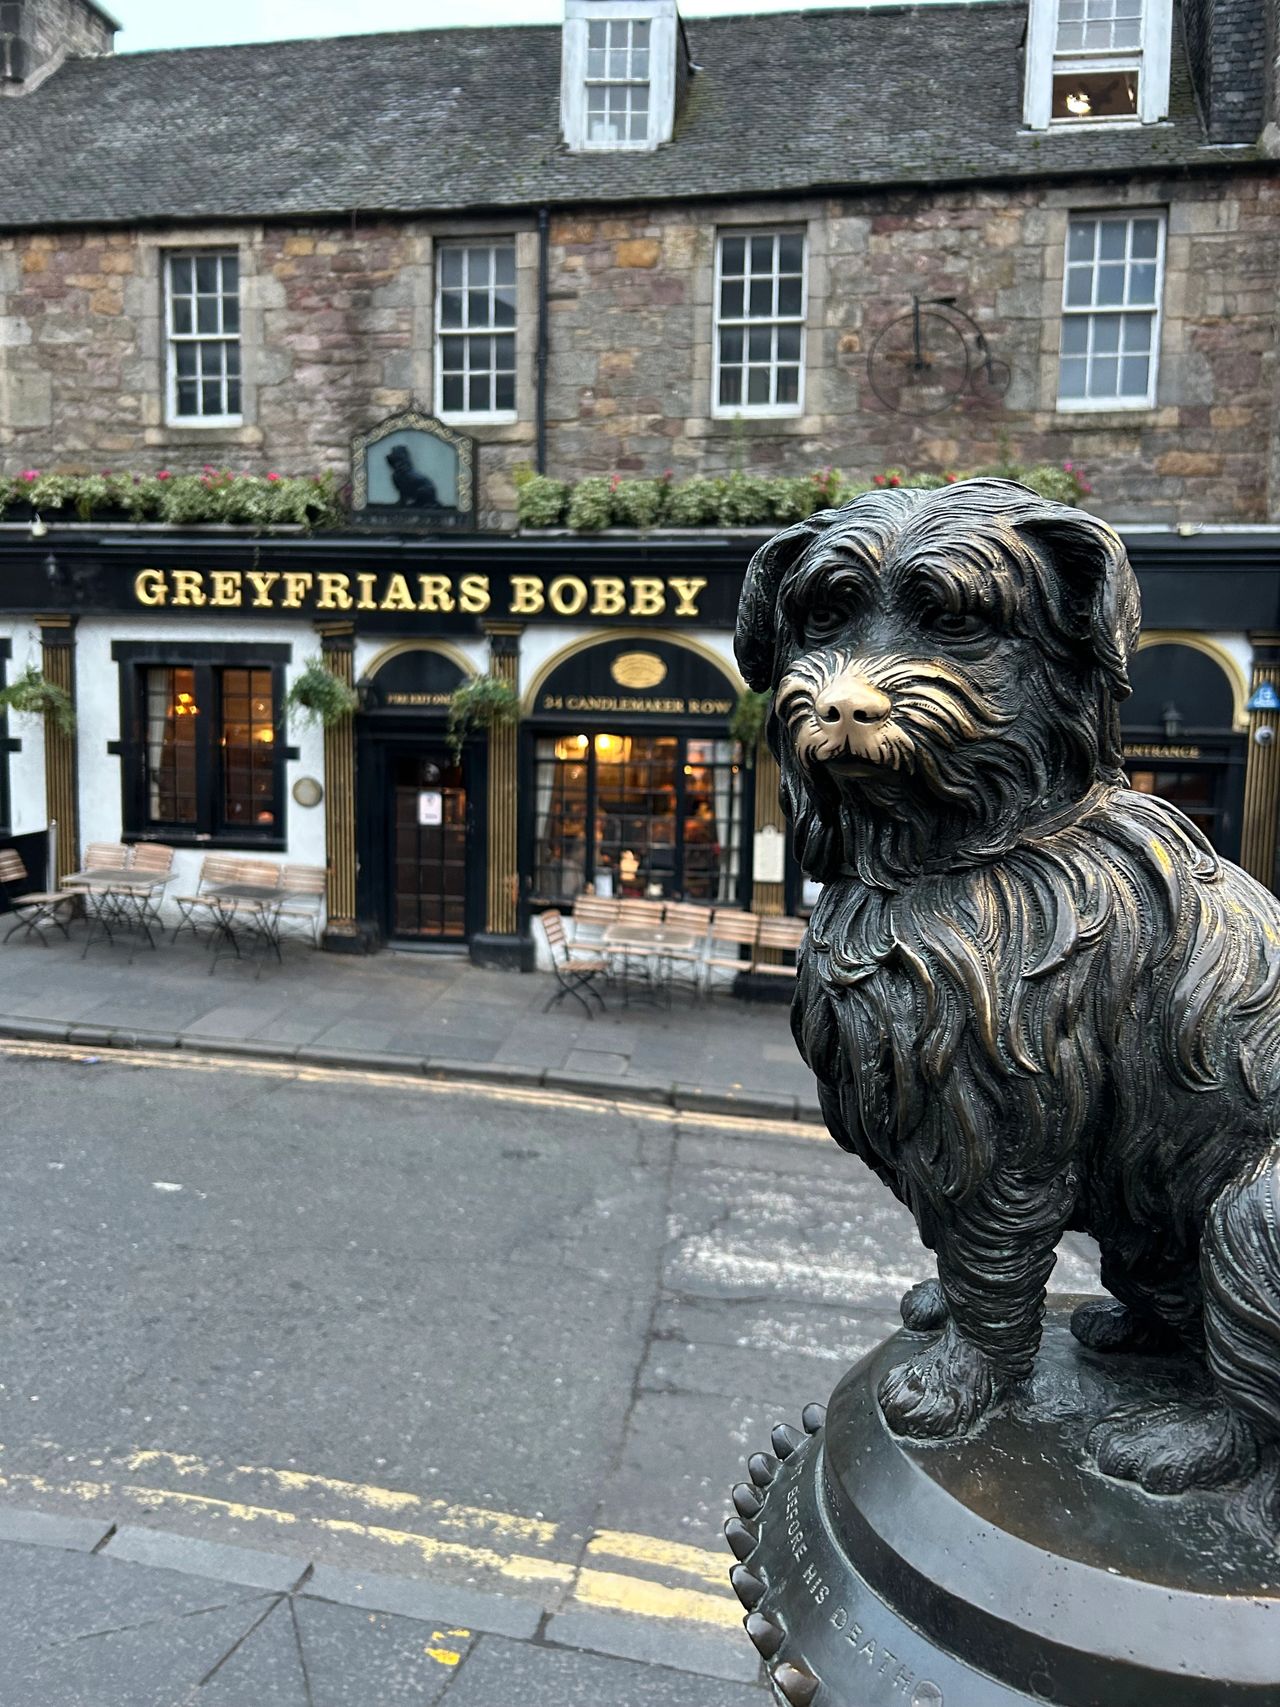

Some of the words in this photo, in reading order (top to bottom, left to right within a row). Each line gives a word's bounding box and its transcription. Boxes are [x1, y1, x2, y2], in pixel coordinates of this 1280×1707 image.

[135, 568, 492, 612] GREYFRIARS
[509, 574, 708, 616] BOBBY
[567, 694, 684, 713] CANDLEMAKER
[688, 699, 732, 714] ROW
[1123, 743, 1200, 759] ENTRANCE
[786, 1485, 808, 1562] BEFORE
[802, 1562, 830, 1605] HIS
[829, 1605, 915, 1694] DEATH
